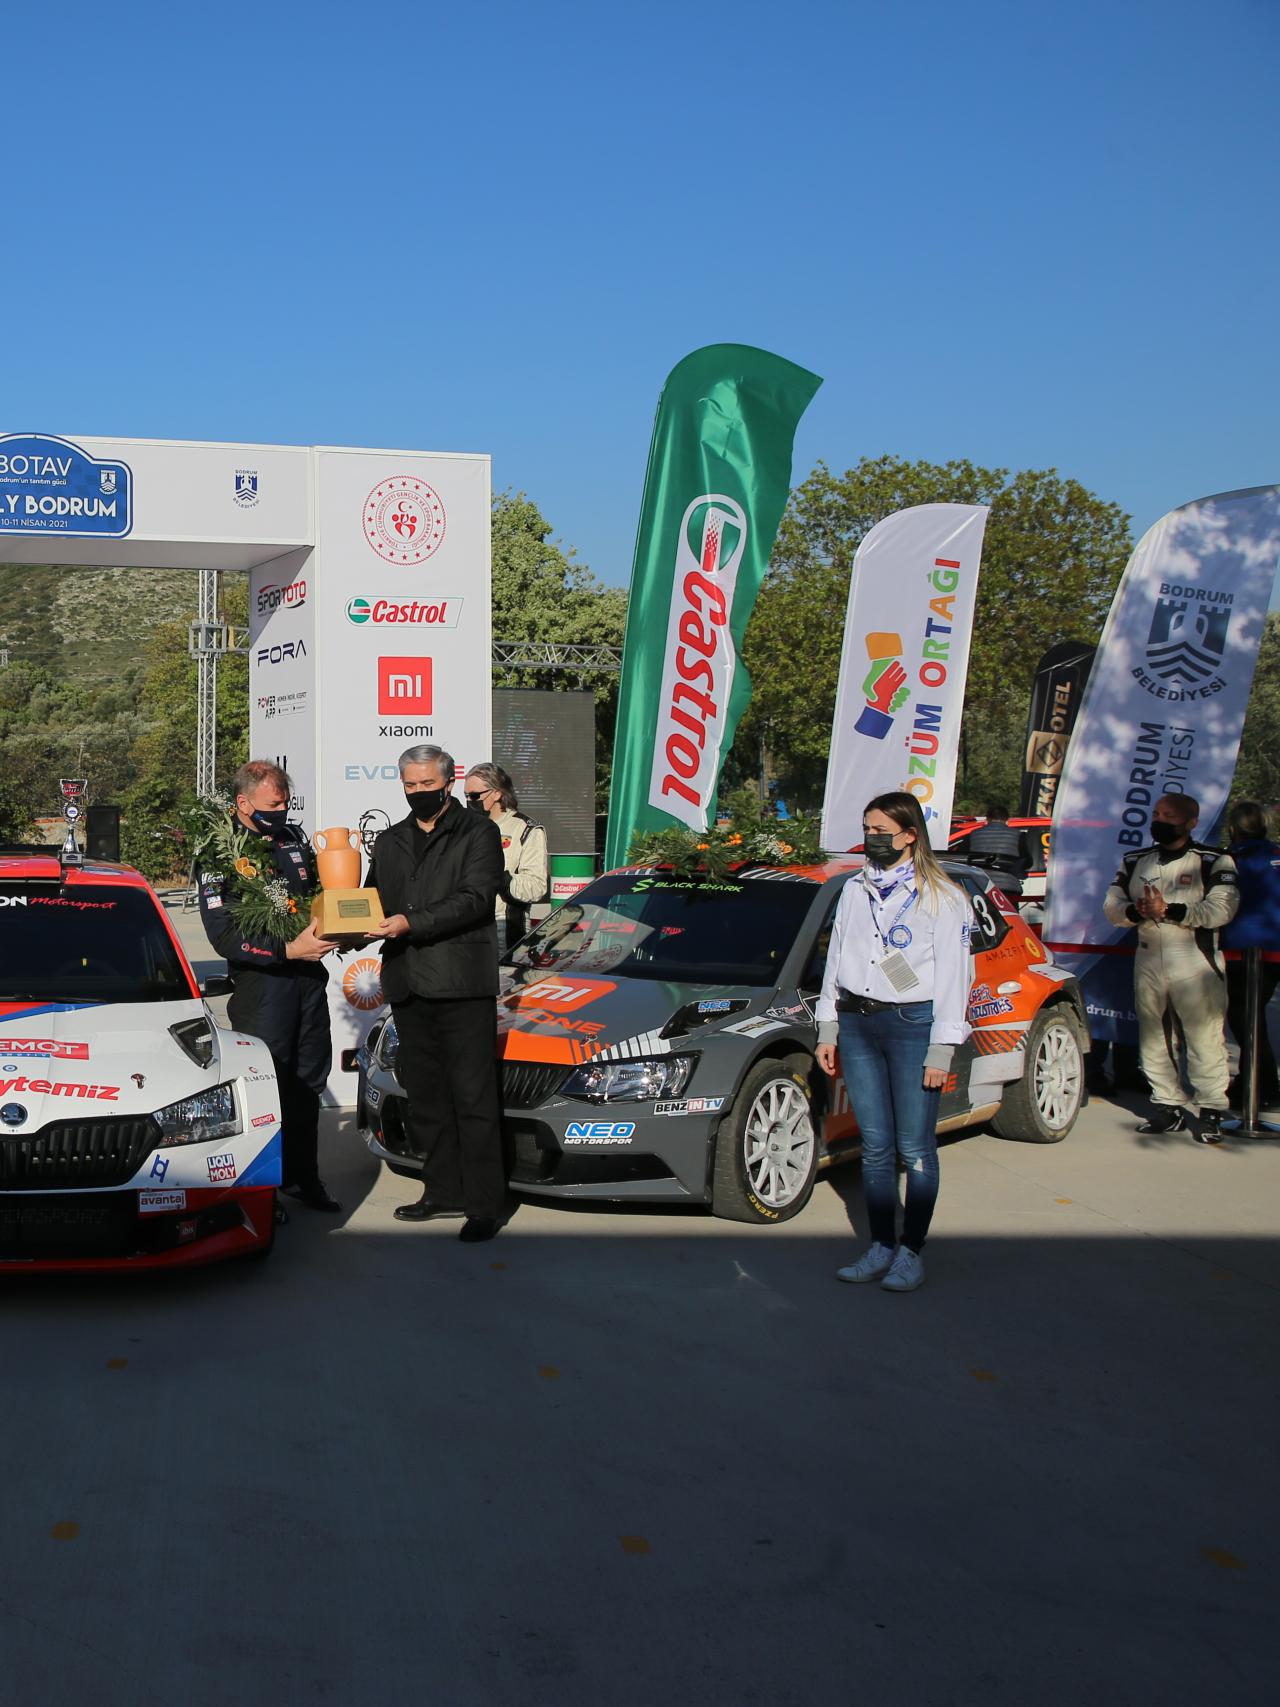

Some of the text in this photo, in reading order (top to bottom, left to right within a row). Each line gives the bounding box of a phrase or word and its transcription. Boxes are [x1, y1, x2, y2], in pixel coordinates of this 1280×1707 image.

[52, 479, 67, 487] gücü
[26, 495, 117, 517] BODRUM
[1, 518, 68, 528] 10-11 NİSAN 2021
[1160, 582, 1235, 605] BODRUM
[373, 600, 447, 623] Castrol
[919, 558, 961, 688] ORTAĞI
[257, 639, 307, 667] FORA
[662, 570, 726, 806] Castrol
[1130, 666, 1227, 703] BELEDİYESİ
[258, 695, 276, 709] POWER
[1050, 681, 1070, 732] OTEL
[265, 707, 276, 720] APP
[379, 725, 433, 737] xiaomi
[1118, 721, 1166, 848] BODRUM
[697, 883, 744, 893] SHARK
[31, 896, 117, 910] Motorsport
[972, 894, 996, 937] 3
[698, 1000, 731, 1010] NEO
[567, 1122, 634, 1137] NEO
[208, 1154, 234, 1167] LIQUI
[210, 1167, 236, 1181] MOLY
[141, 1193, 185, 1206] avantaj
